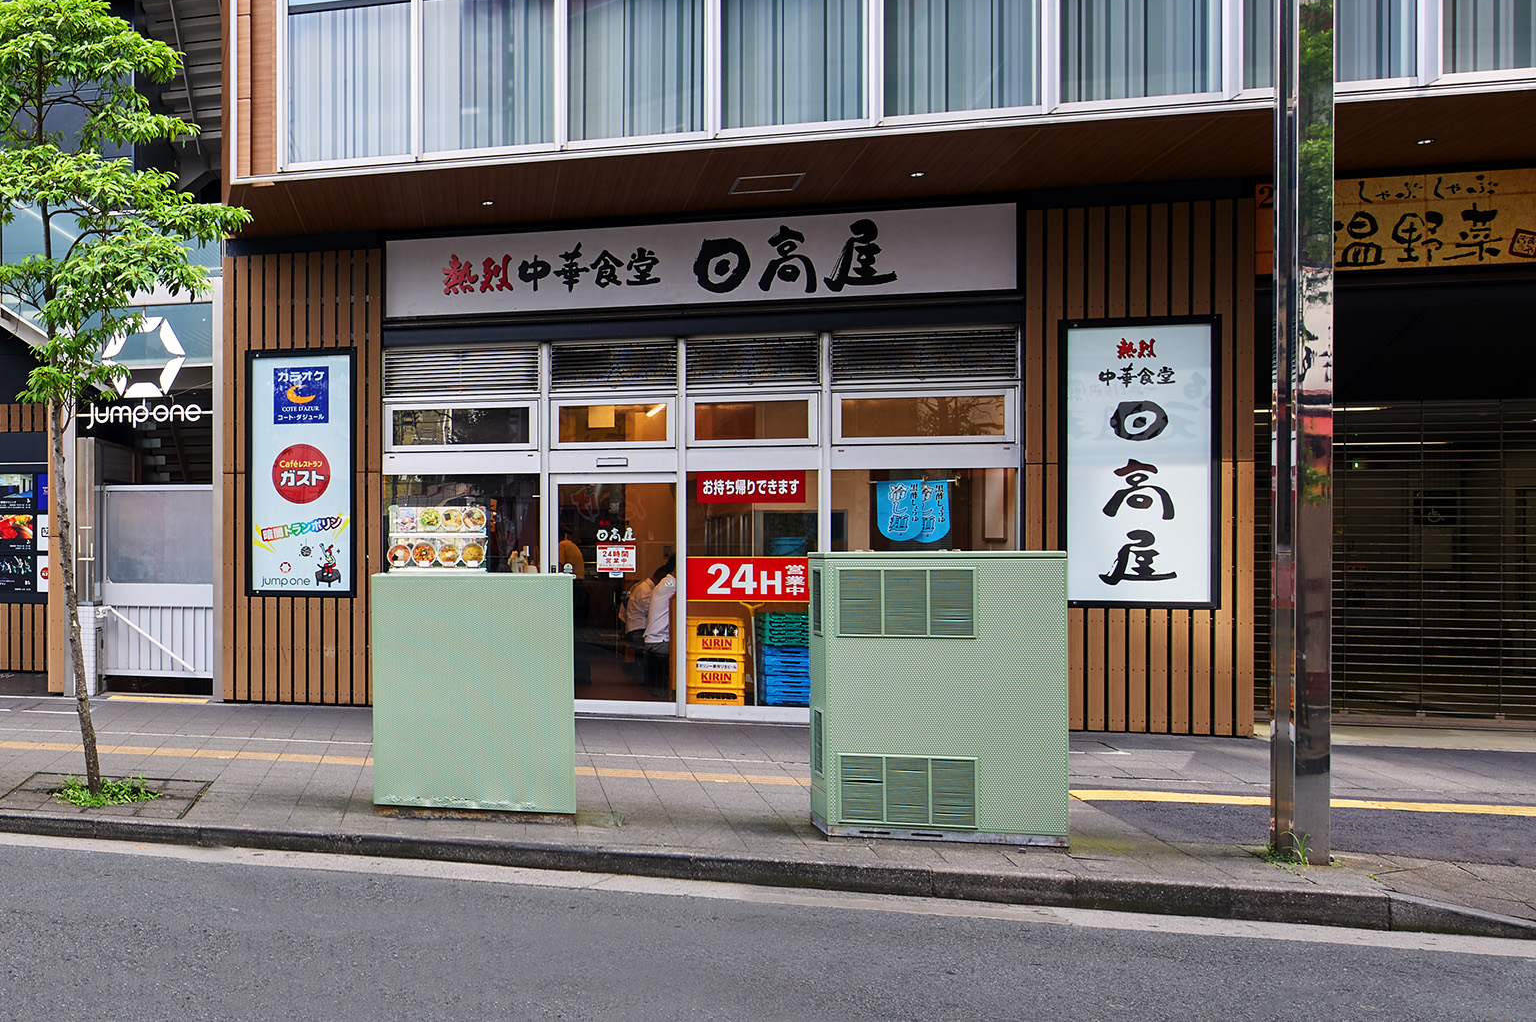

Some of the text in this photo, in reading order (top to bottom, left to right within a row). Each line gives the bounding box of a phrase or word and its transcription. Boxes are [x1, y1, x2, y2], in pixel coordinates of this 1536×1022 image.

[1358, 174, 1499, 204] しゃぶしゃぶ
[692, 218, 898, 295] 日高屋
[1116, 337, 1157, 360] 熱烈
[277, 370, 325, 382] カラオケ
[1098, 363, 1176, 388] 中華食堂
[279, 470, 326, 488] ガスト
[702, 478, 800, 496] お持ち帰りできます
[1098, 400, 1178, 586] 日高屋
[701, 638, 733, 647] KIRIN
[700, 672, 732, 681] KIRIN
